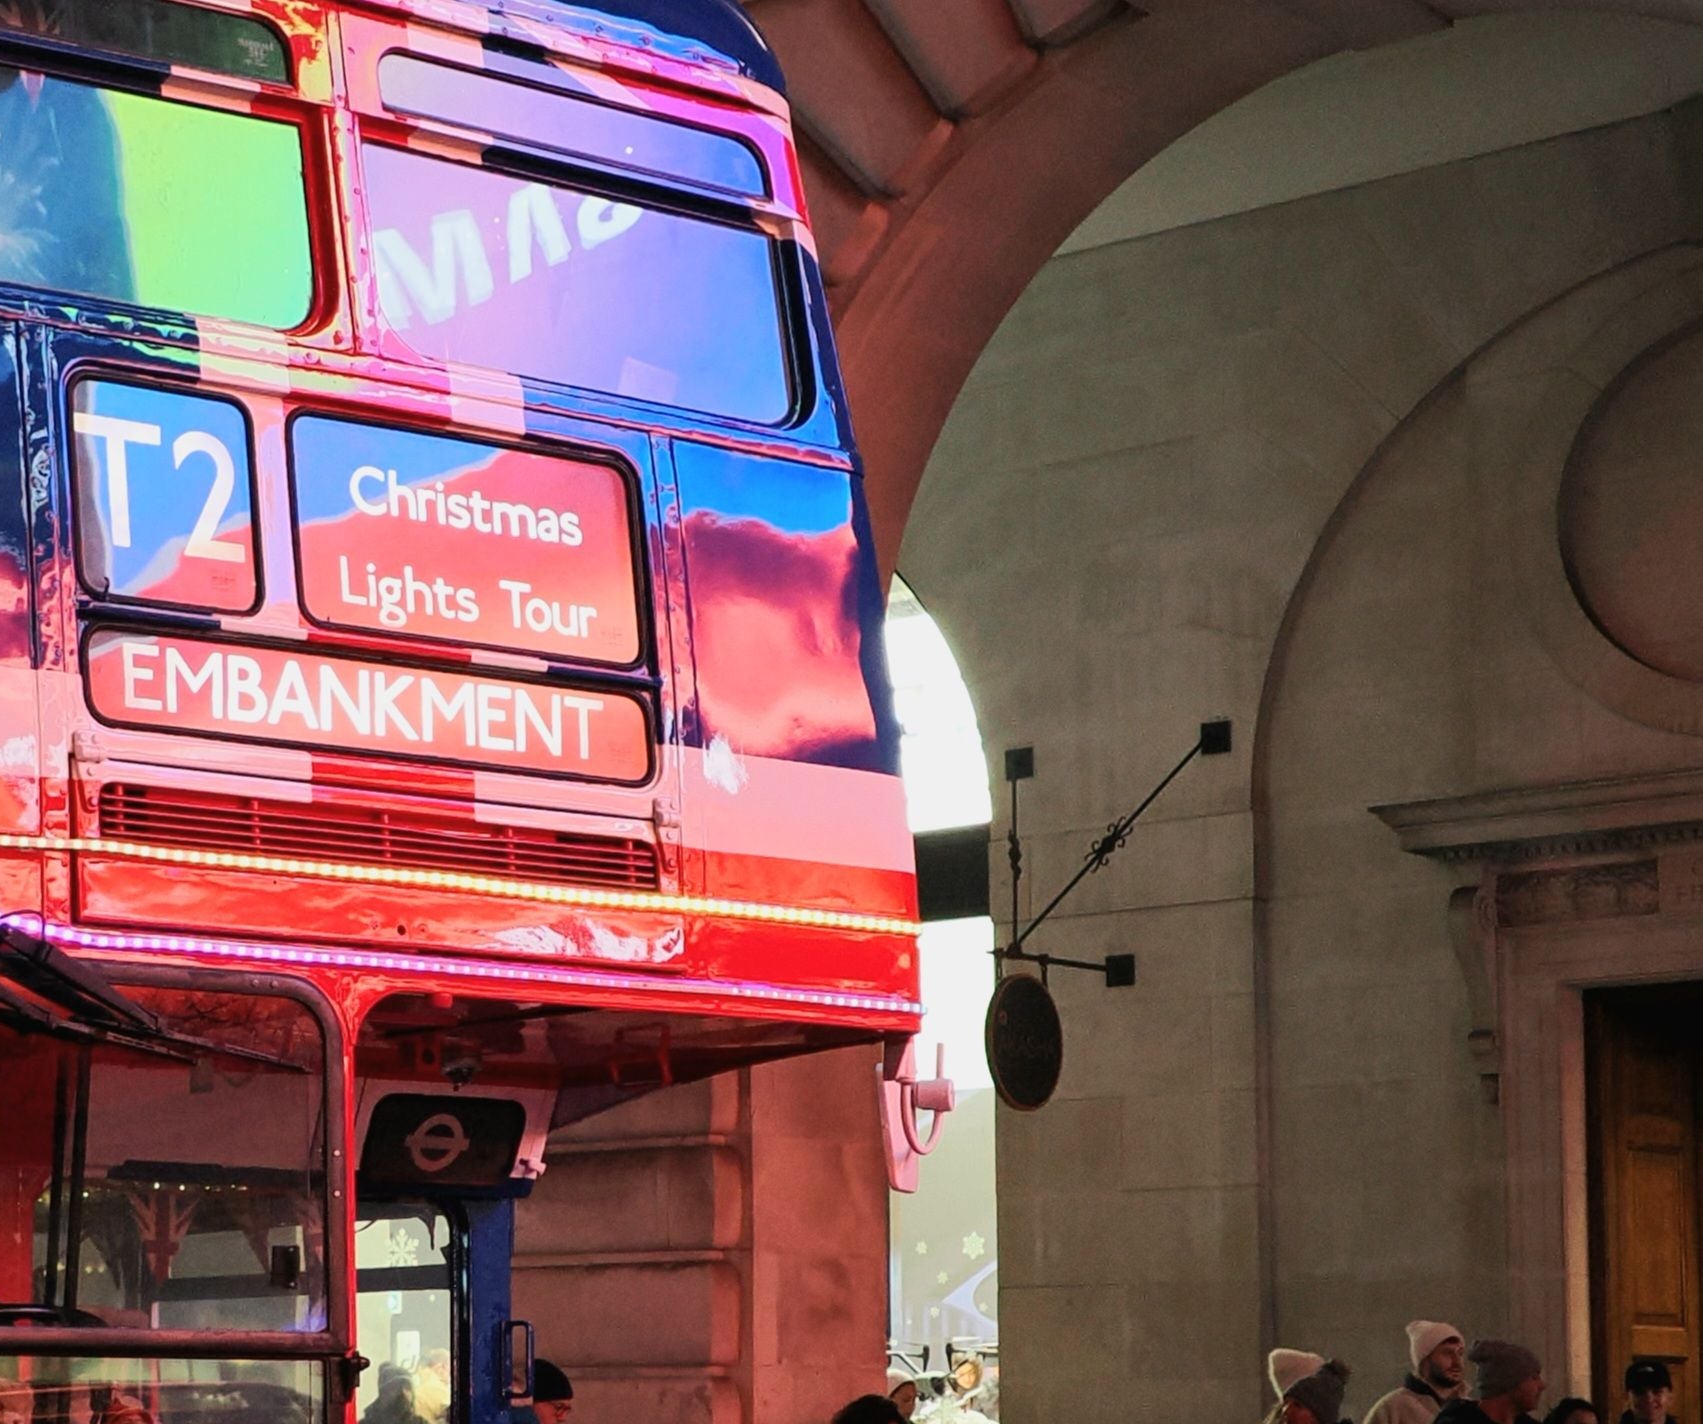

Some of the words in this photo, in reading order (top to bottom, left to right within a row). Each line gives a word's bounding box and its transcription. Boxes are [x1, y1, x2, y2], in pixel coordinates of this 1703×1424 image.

[73, 412, 247, 564] T2
[348, 465, 584, 547] Christmas
[338, 555, 480, 629] Lights
[498, 579, 598, 639] Tour
[121, 641, 605, 760] EMBANKMENT
